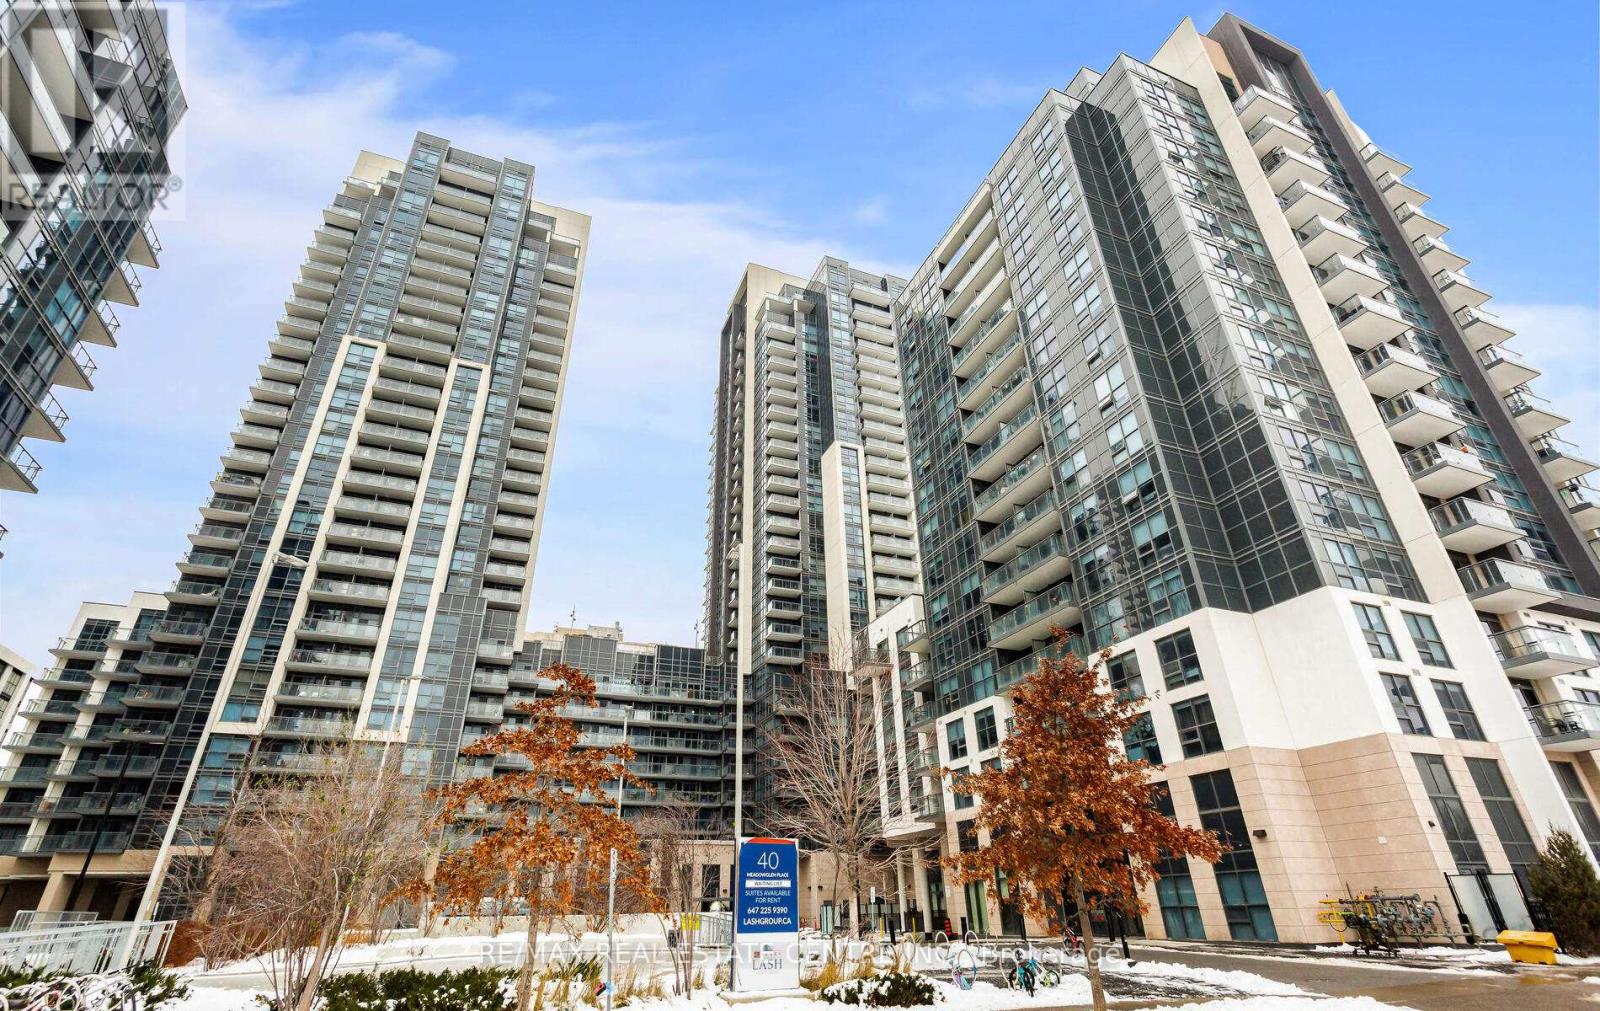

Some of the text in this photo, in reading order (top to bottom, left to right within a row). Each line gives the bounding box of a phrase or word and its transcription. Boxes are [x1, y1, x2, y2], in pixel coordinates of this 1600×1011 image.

[757, 851, 779, 870] 40
[745, 889, 791, 897] SUITES AVAILABLE
[747, 906, 789, 915] 647 225 9390
[743, 917, 792, 926] LASHGROUP.CA
[752, 958, 783, 971] LASH
